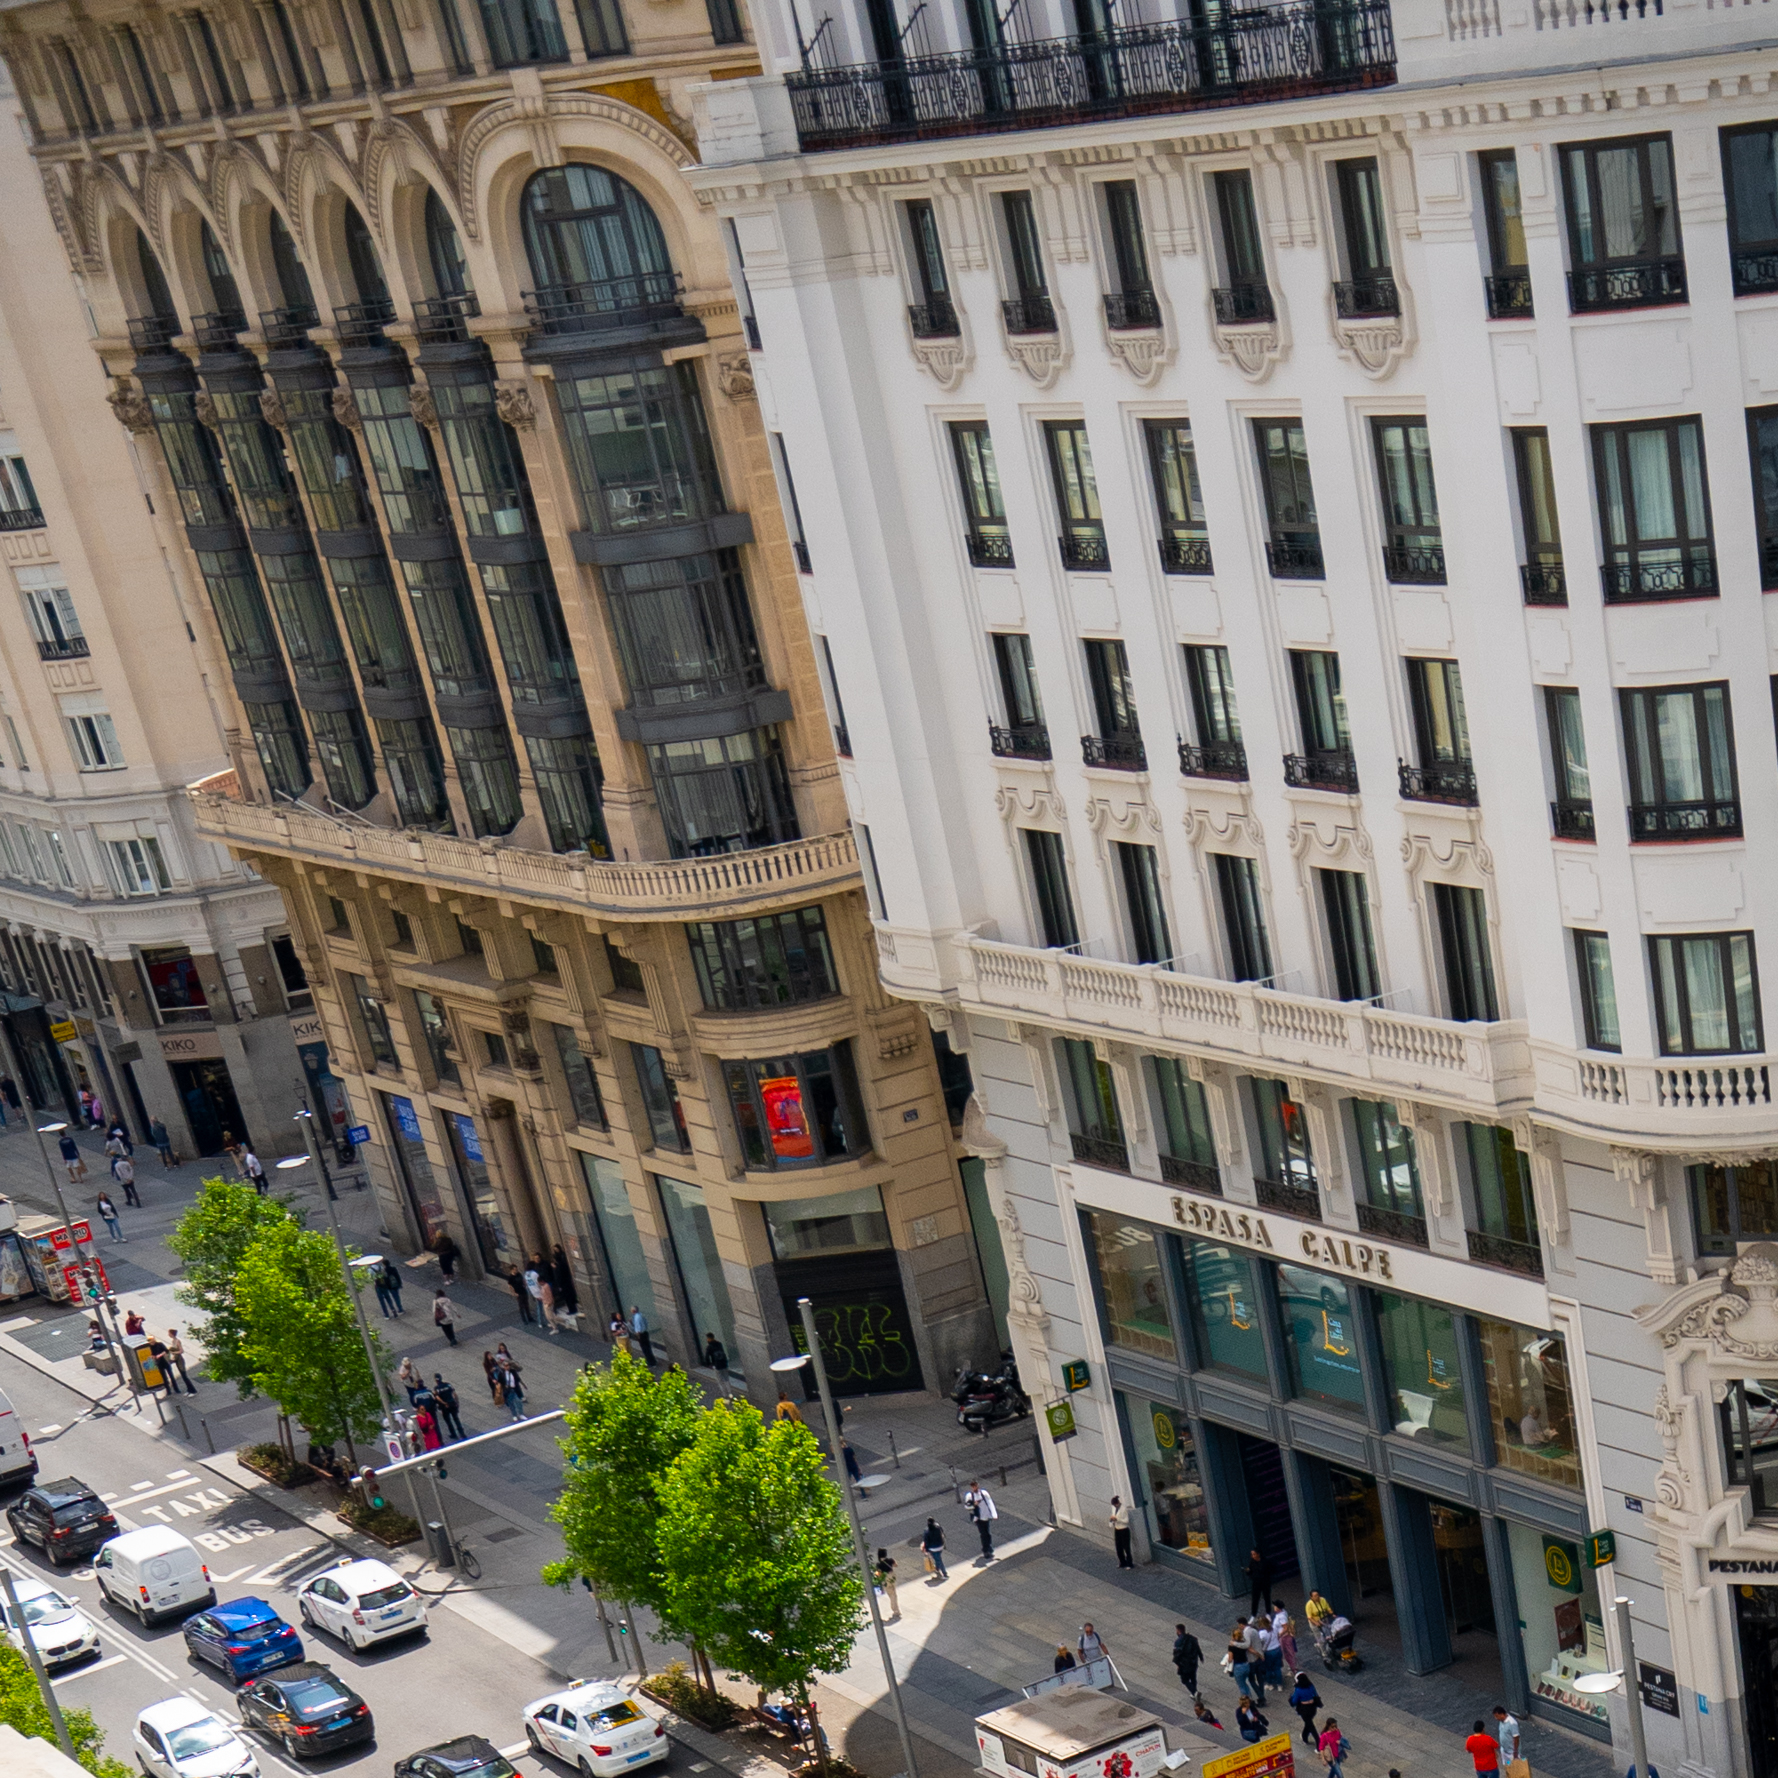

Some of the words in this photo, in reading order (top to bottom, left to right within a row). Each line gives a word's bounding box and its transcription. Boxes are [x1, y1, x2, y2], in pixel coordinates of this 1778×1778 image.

[293, 1021, 323, 1036] KIK
[161, 1039, 196, 1052] KIKO
[55, 1227, 88, 1245] MARID
[1169, 1196, 1273, 1248] ESPASA
[1299, 1230, 1393, 1280] CALPE
[141, 1488, 234, 1523] TAXI
[194, 1518, 275, 1552] BUS
